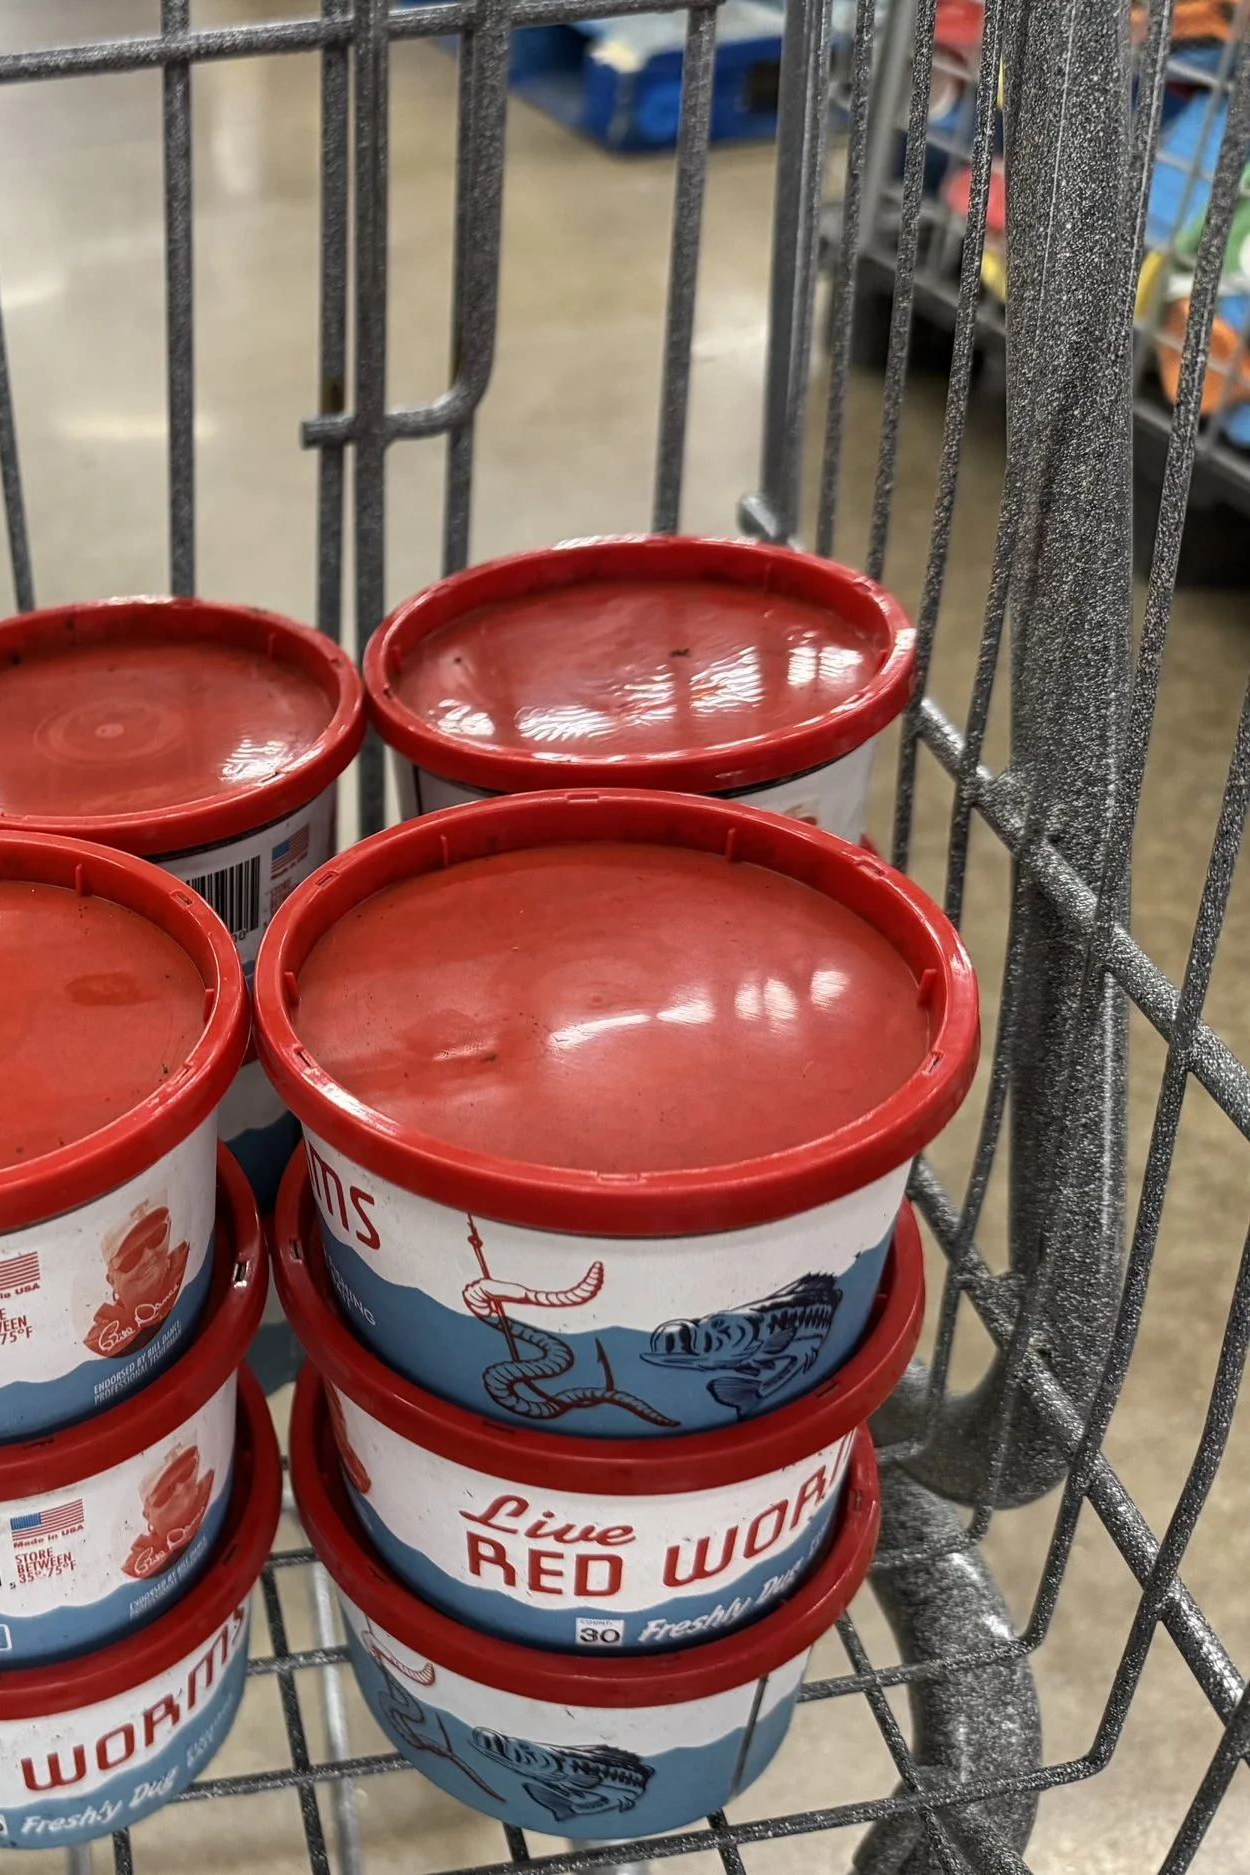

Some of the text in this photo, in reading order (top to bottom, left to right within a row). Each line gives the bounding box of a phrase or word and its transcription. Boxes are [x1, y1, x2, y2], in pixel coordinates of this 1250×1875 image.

[0, 1291, 12, 1300] in
[14, 1283, 40, 1296] USA
[93, 1361, 136, 1395] ENDORSED
[136, 1353, 147, 1368] BY
[13, 1523, 84, 1549] Made in USA
[458, 1494, 637, 1547] Live
[14, 1546, 54, 1565] STORE
[16, 1551, 72, 1575] BETWEEN
[466, 1530, 624, 1598] RED
[638, 1596, 752, 1643] Freshly
[579, 1626, 620, 1645] 30
[21, 1800, 124, 1836] Freshly
